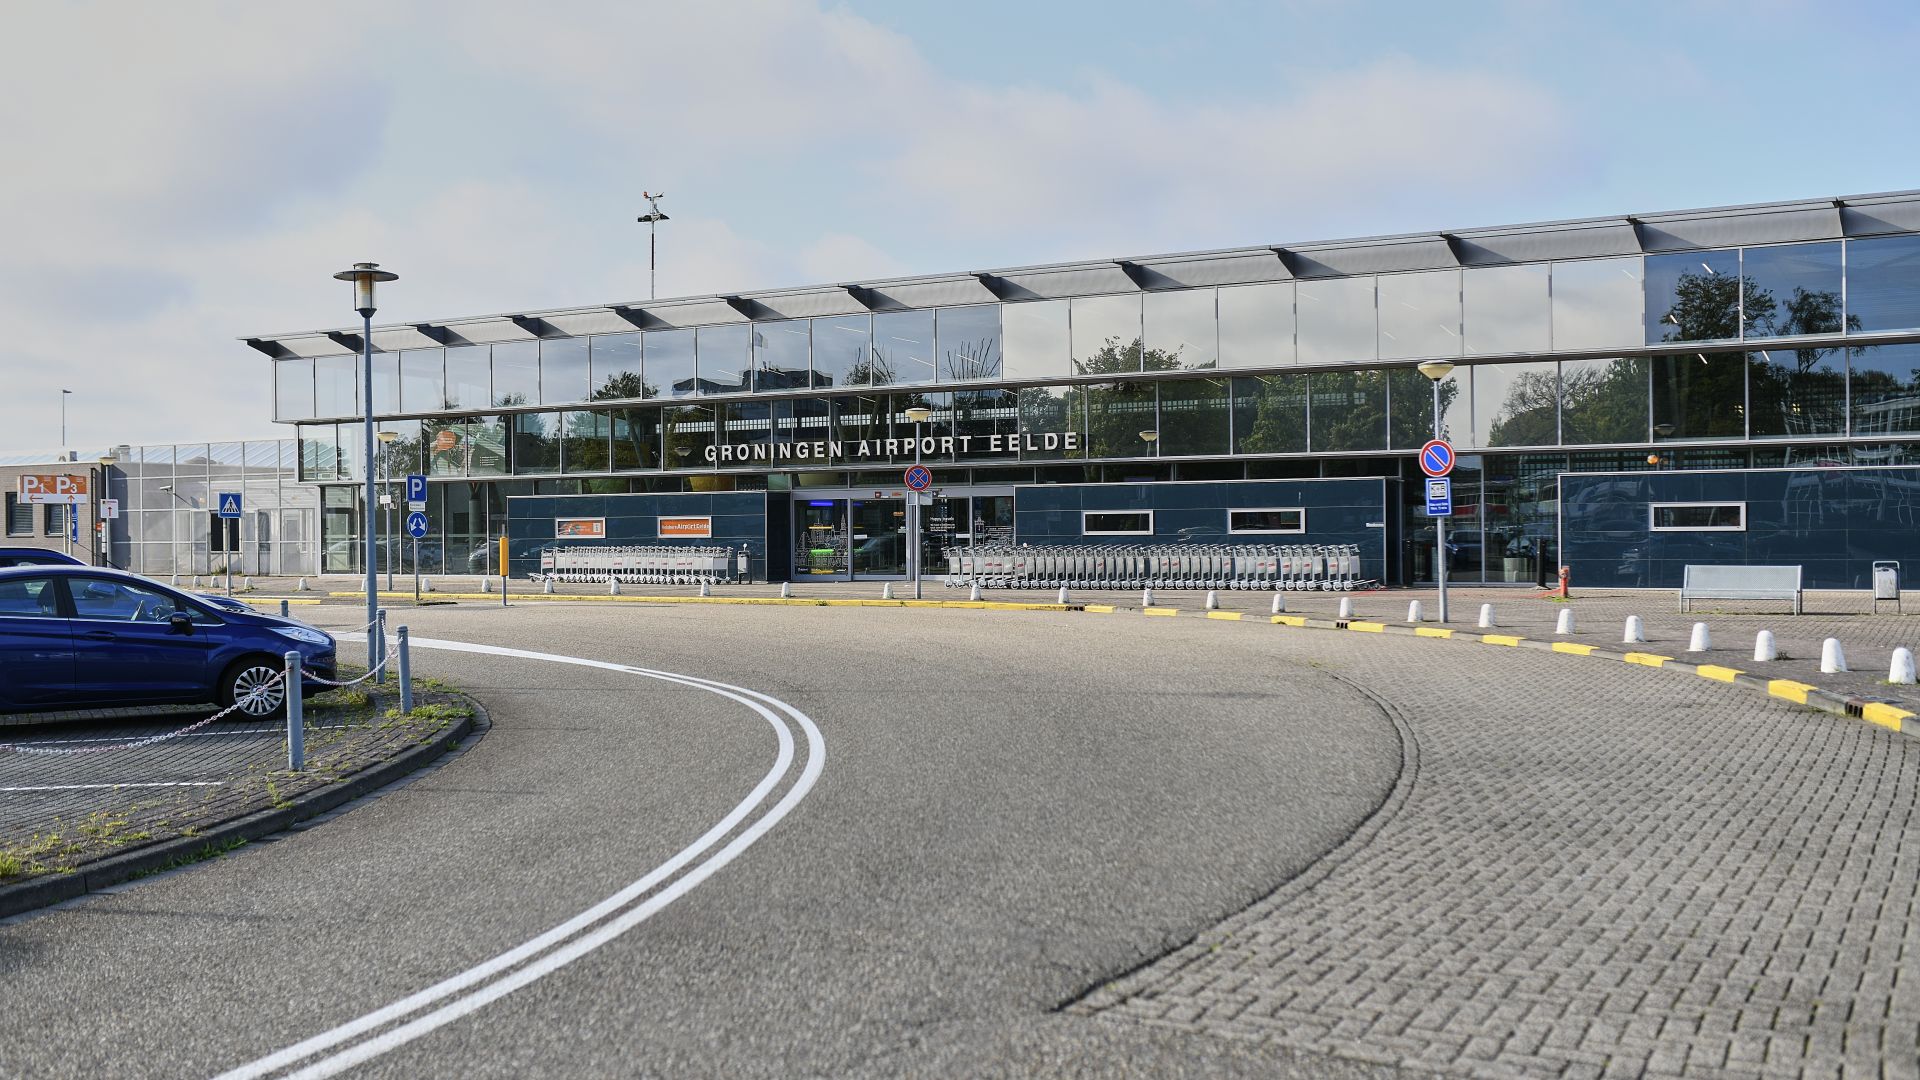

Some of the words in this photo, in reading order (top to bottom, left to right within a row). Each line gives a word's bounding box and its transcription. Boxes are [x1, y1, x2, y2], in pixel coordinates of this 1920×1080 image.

[704, 441, 842, 462] GRONINGEN
[858, 435, 971, 456] AIRPORT
[990, 432, 1077, 452] EELDE
[411, 478, 423, 499] P
